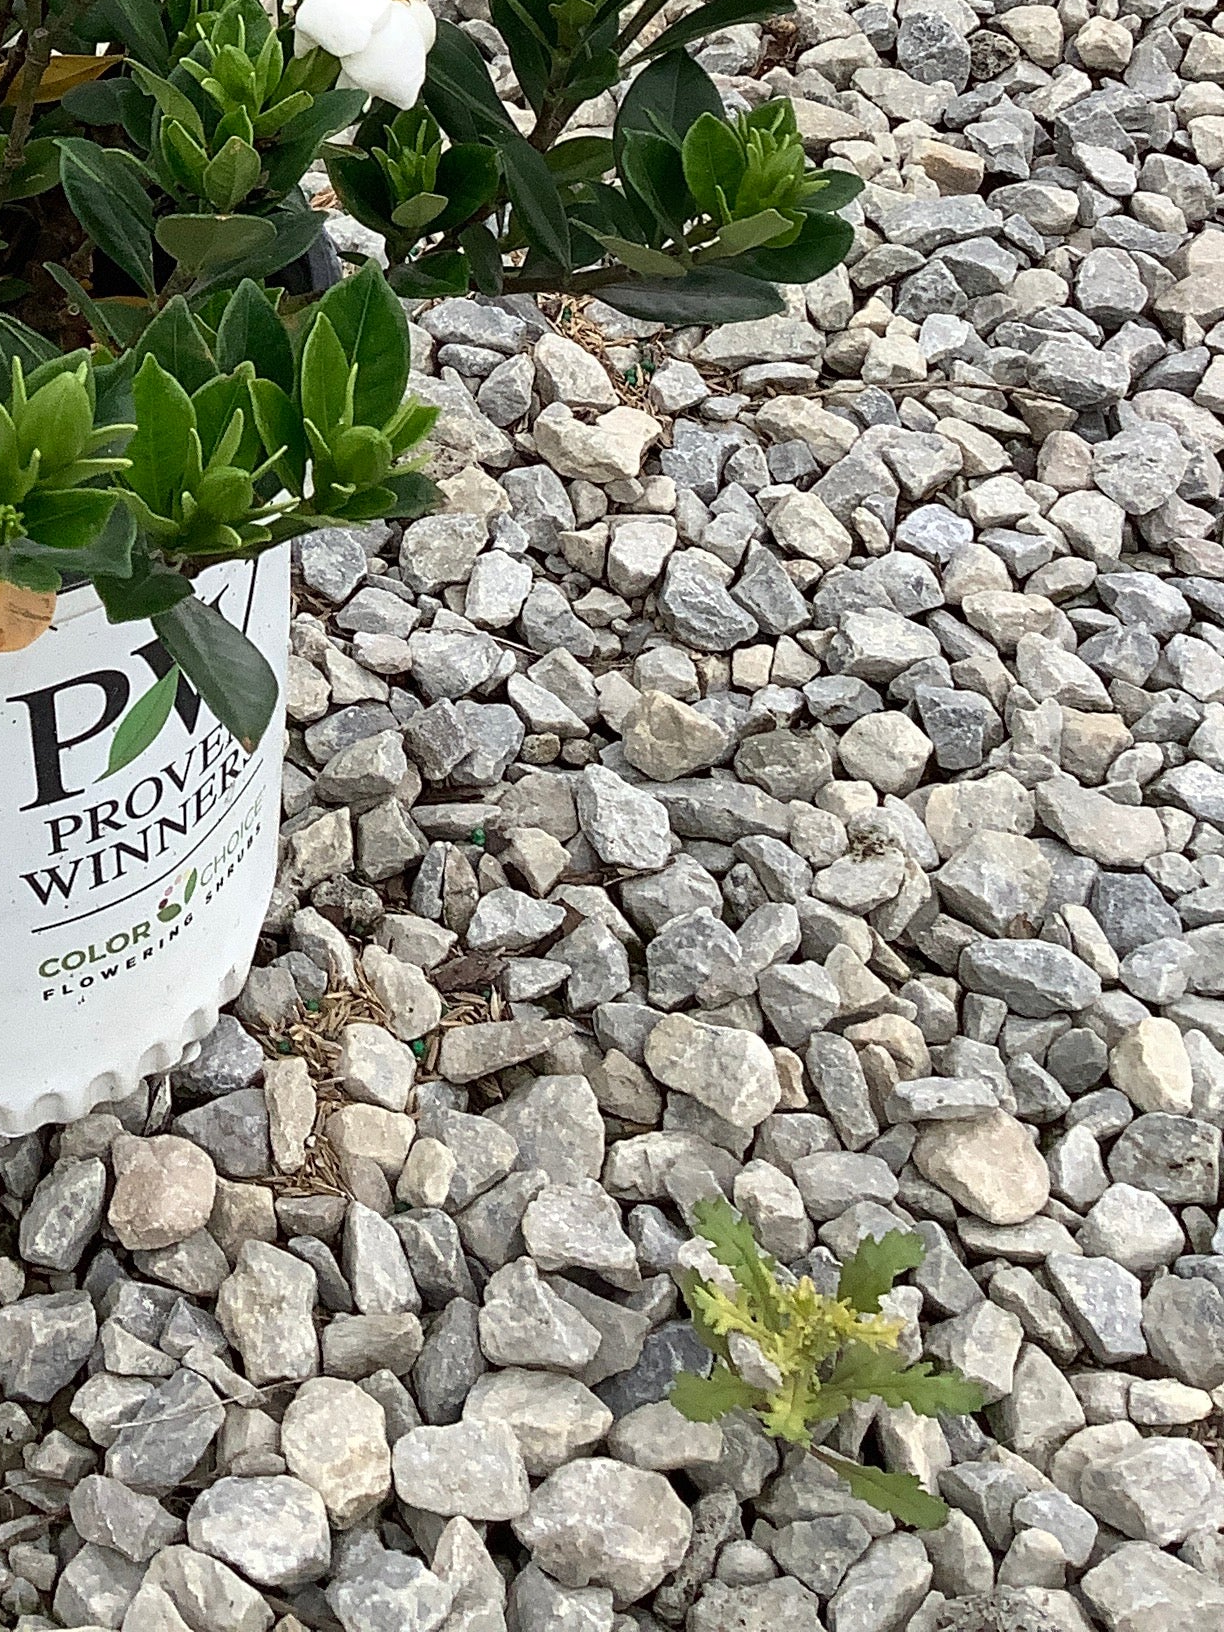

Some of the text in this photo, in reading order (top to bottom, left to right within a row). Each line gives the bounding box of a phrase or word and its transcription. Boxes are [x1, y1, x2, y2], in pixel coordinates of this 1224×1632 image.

[18, 747, 254, 907] WINNER
[37, 790, 264, 979] COLOR CHOICE
[42, 821, 262, 1003] FLOWERING SHRUBS
